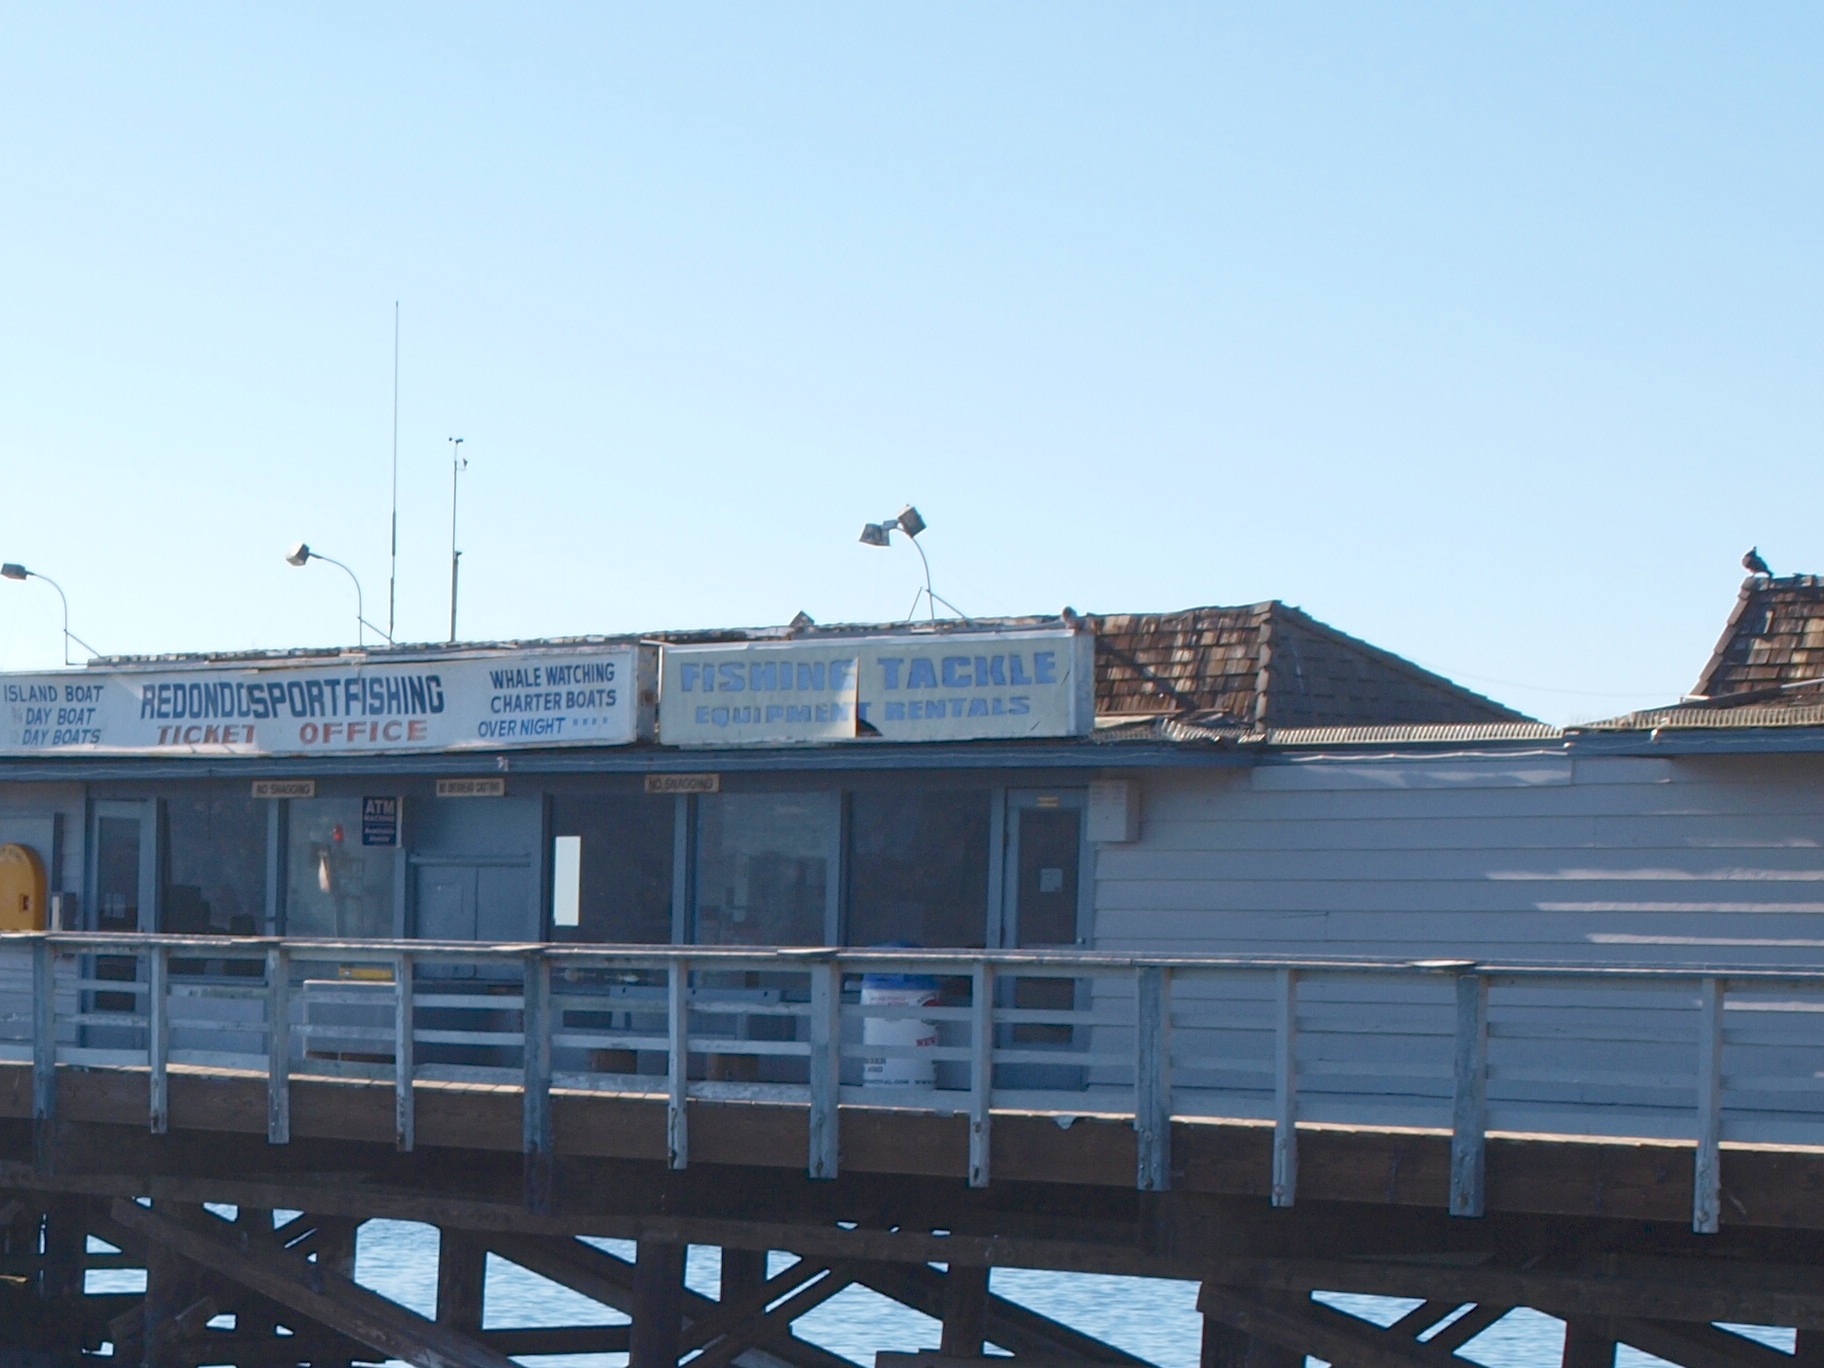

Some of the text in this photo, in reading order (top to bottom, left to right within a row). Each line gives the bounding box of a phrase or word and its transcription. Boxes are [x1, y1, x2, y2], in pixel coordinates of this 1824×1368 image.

[490, 662, 614, 689] WHALE WATCHING
[680, 652, 1058, 692] FISHING TACKLE
[4, 685, 104, 703] ISLAND BOAT
[491, 689, 617, 713] CHARTER BOATS
[26, 707, 52, 725] DAY
[57, 707, 96, 725] BOAT
[695, 696, 1031, 728] EQUIPMENT RENTALS
[22, 729, 49, 745] DAY
[52, 728, 102, 745] BOATS
[157, 719, 428, 745] TICKET OFFICE
[256, 783, 268, 795] NO
[649, 778, 662, 790] NO
[365, 799, 395, 815] ATM
